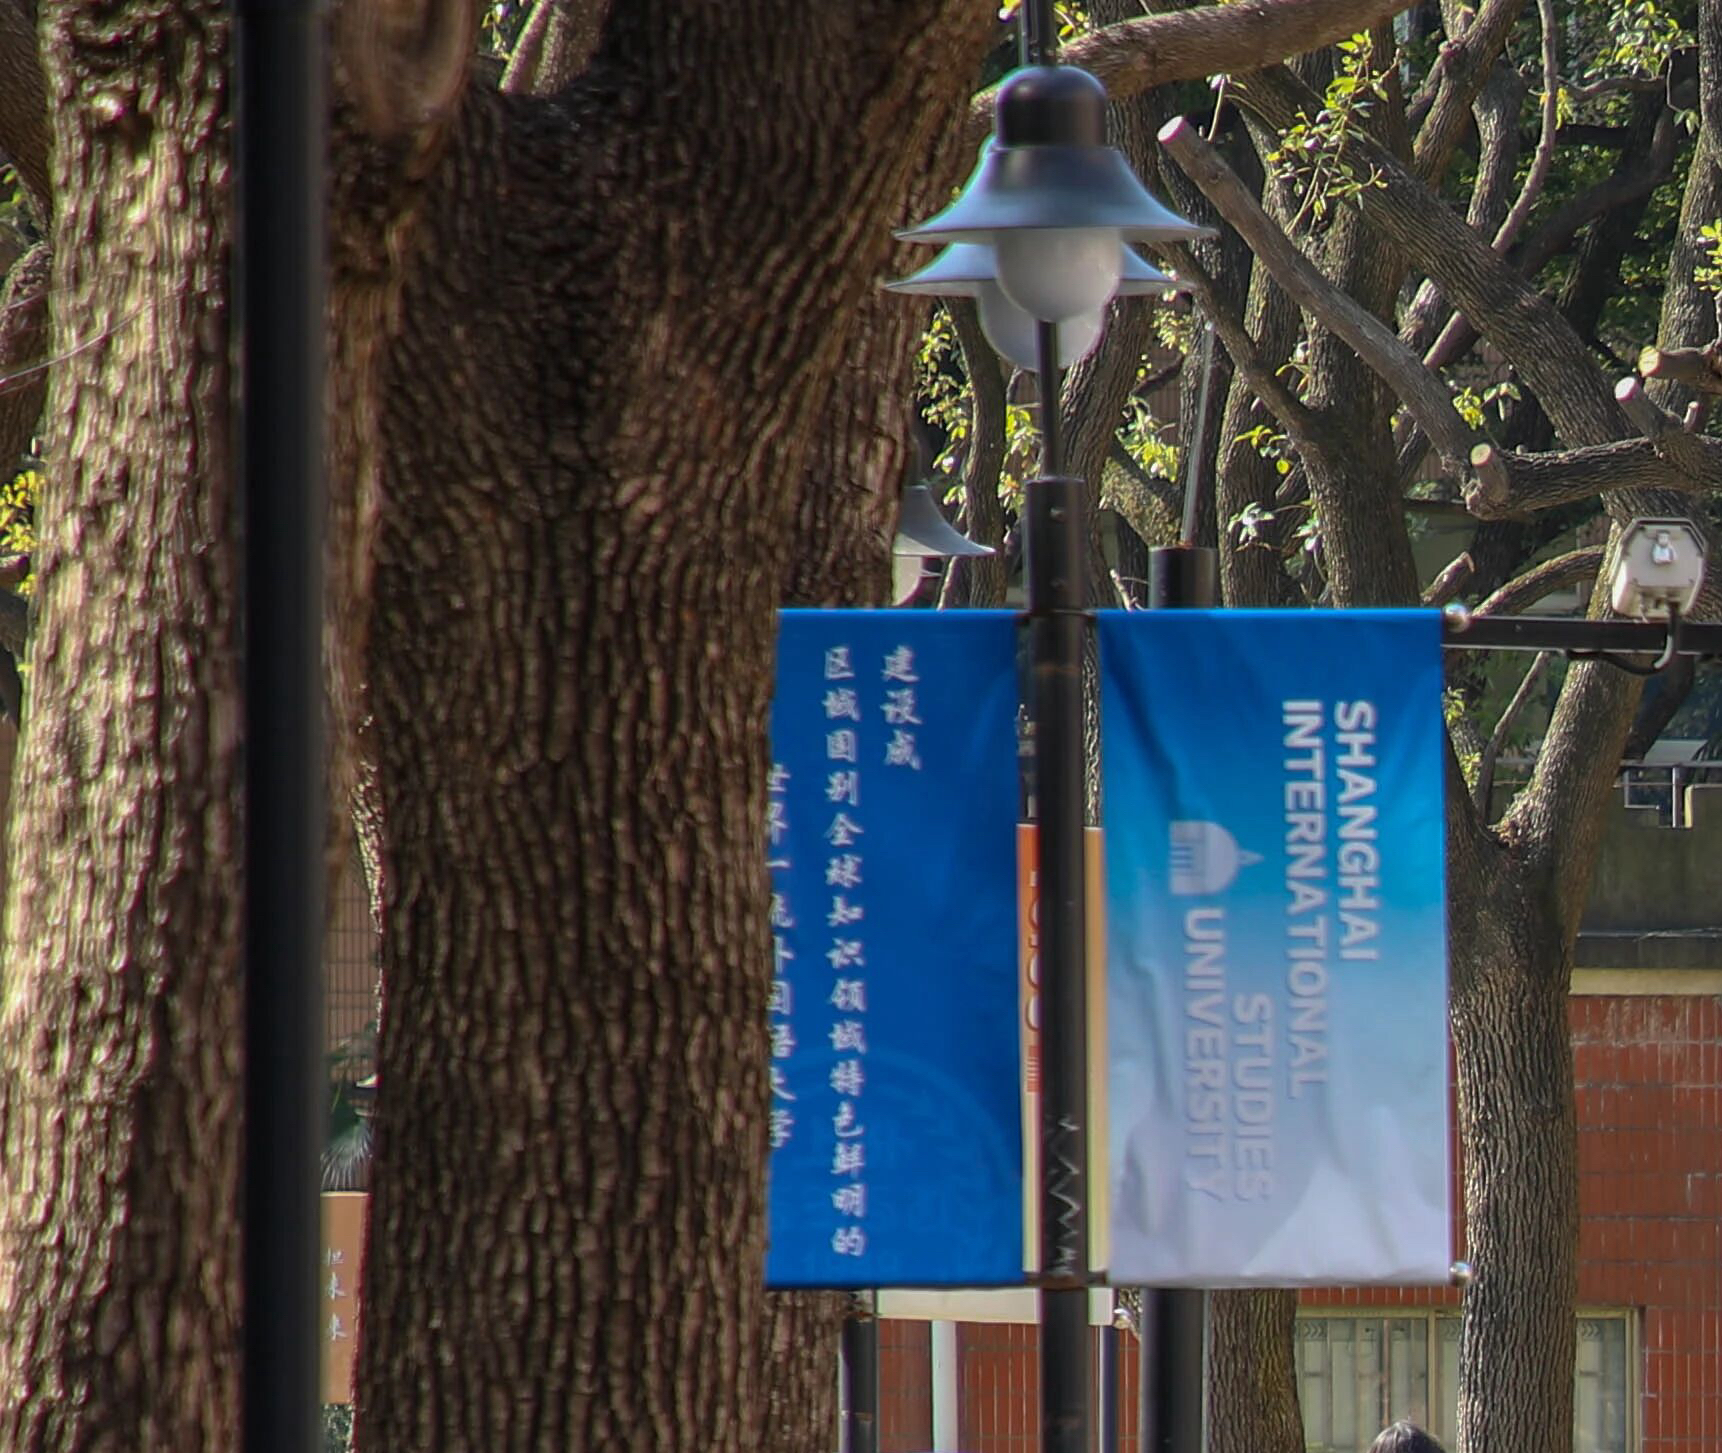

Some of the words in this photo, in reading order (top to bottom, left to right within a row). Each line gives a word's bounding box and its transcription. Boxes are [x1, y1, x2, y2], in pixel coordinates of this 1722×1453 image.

[880, 645, 922, 770] 建设成
[1334, 699, 1380, 962] SHANGHAI
[1282, 699, 1329, 1100] INTERNATIONAL
[1183, 907, 1227, 1204] UNIVERSITY
[1233, 993, 1274, 1203] STUDIES
